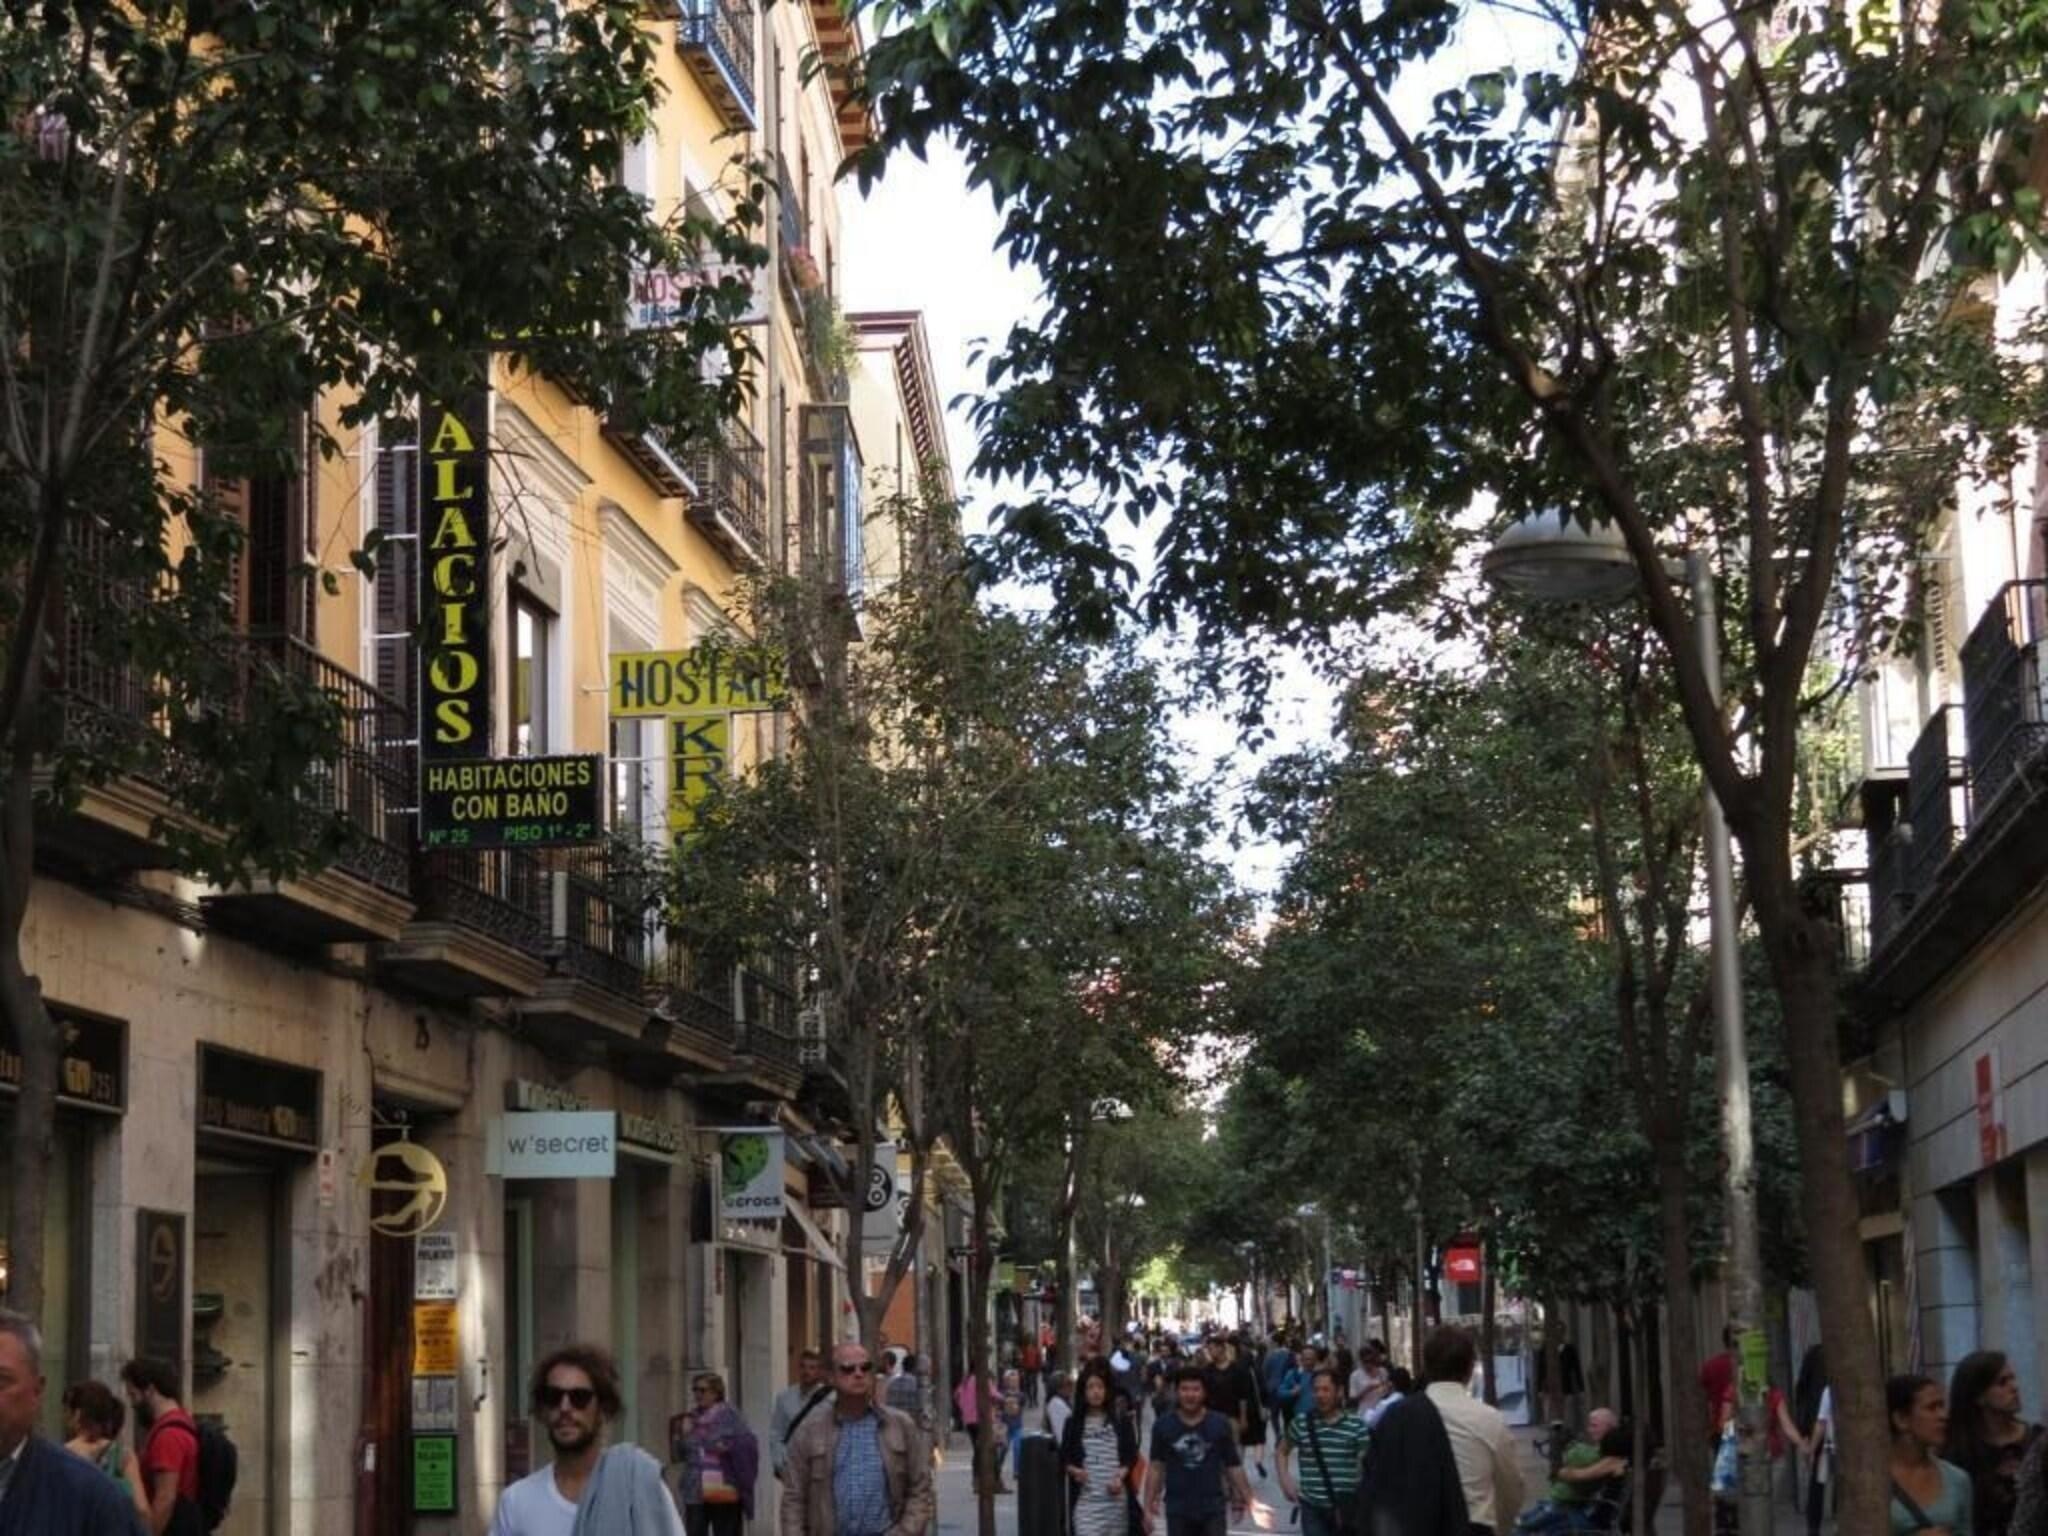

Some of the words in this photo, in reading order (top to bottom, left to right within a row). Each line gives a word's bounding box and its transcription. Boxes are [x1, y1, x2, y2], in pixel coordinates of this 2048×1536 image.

[430, 398, 478, 744] ALACIOS
[428, 761, 591, 791] HABITACIONES
[451, 795, 498, 820] CON
[505, 788, 568, 818] BAÑO
[504, 825, 542, 841] PISO
